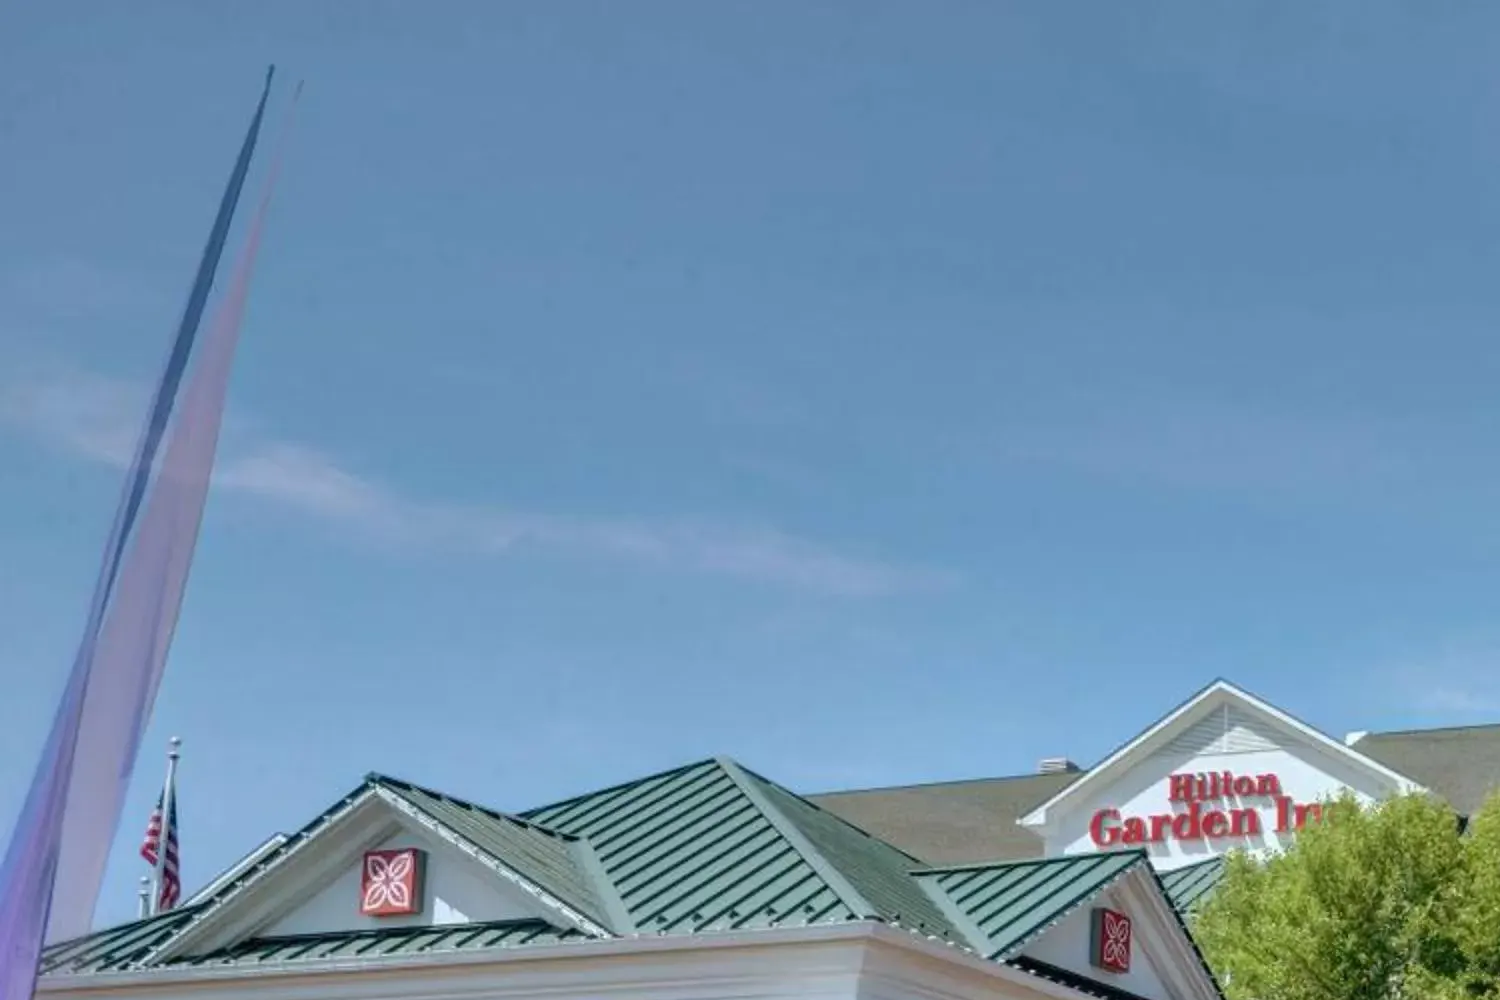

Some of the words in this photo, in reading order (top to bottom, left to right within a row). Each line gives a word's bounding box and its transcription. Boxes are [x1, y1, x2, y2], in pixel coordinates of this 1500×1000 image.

[1168, 770, 1282, 802] Hilton
[1089, 799, 1260, 846] Garden
[1274, 796, 1338, 833] In
